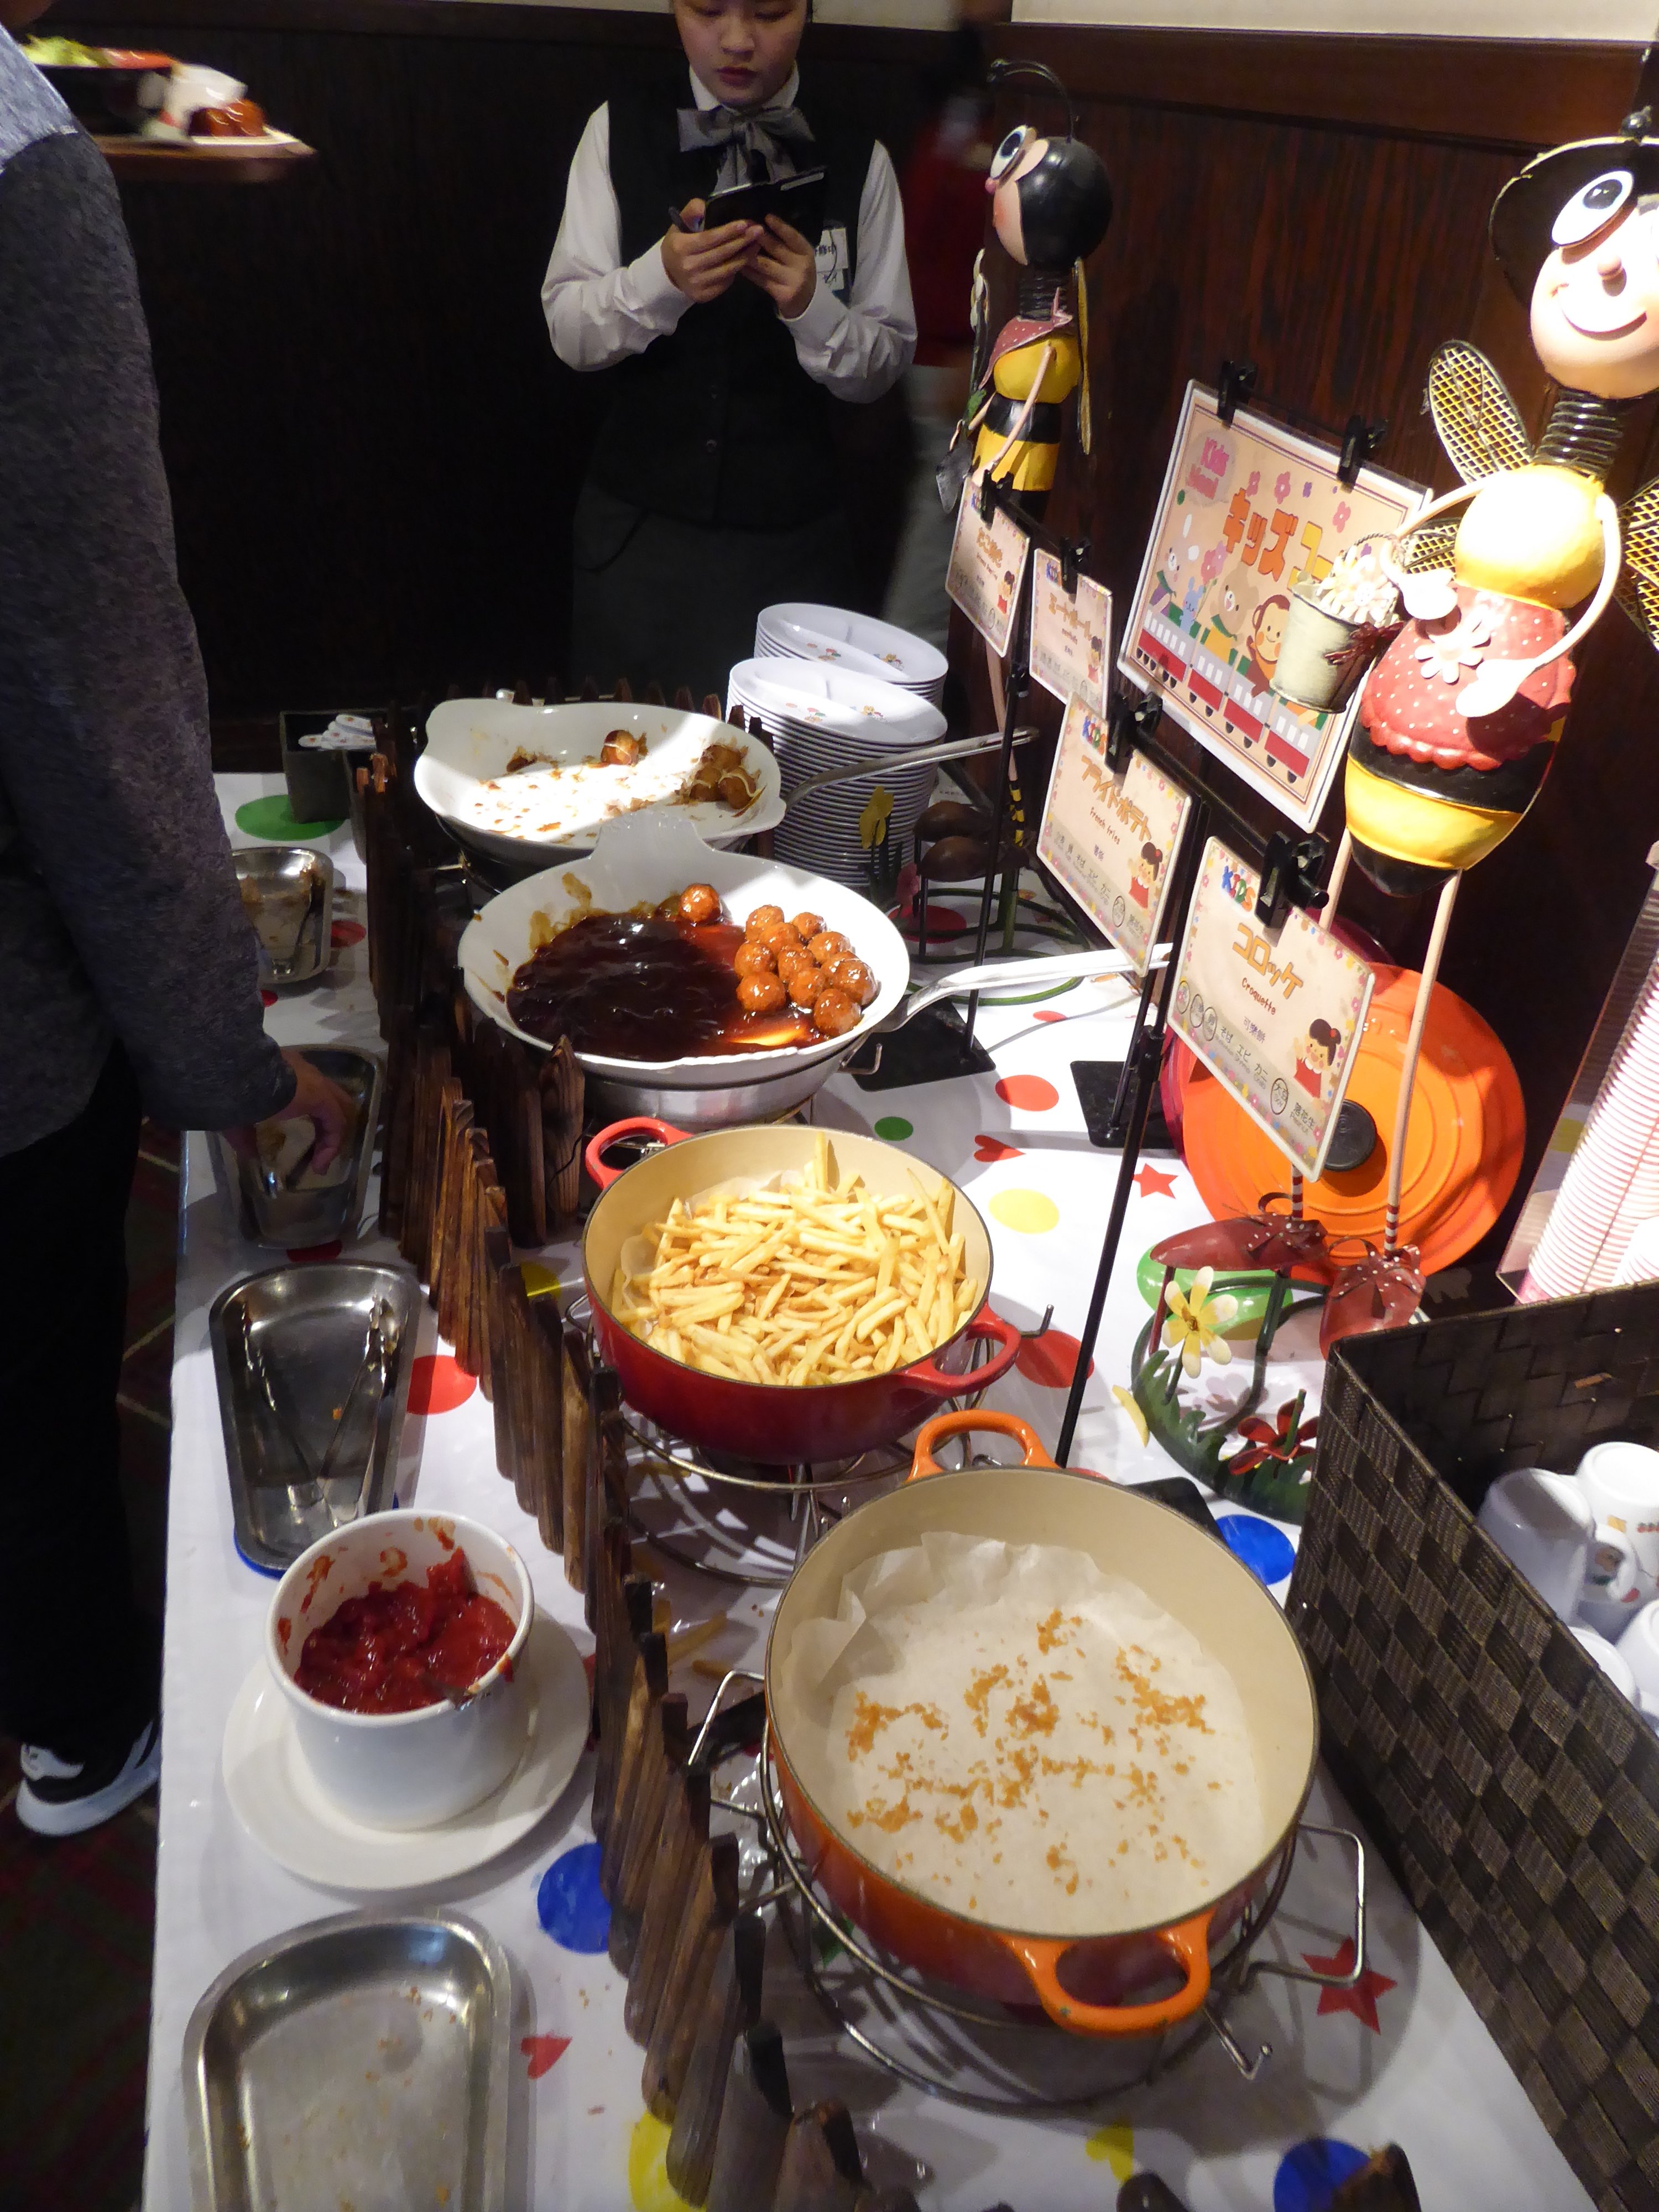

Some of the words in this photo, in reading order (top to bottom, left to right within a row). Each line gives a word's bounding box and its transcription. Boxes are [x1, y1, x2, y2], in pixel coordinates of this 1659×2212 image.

[1082, 716, 1105, 755] KIDS
[1081, 755, 1151, 842] フライドポテト
[1222, 865, 1256, 912] KIDS
[1232, 922, 1304, 1000] コロッケ
[1241, 977, 1276, 1015] Croquette
[1237, 1044, 1251, 1063] エビ
[1254, 1062, 1269, 1083] カニ
[1273, 1082, 1289, 1100] 大豆
[1294, 1102, 1316, 1131] 落花生
